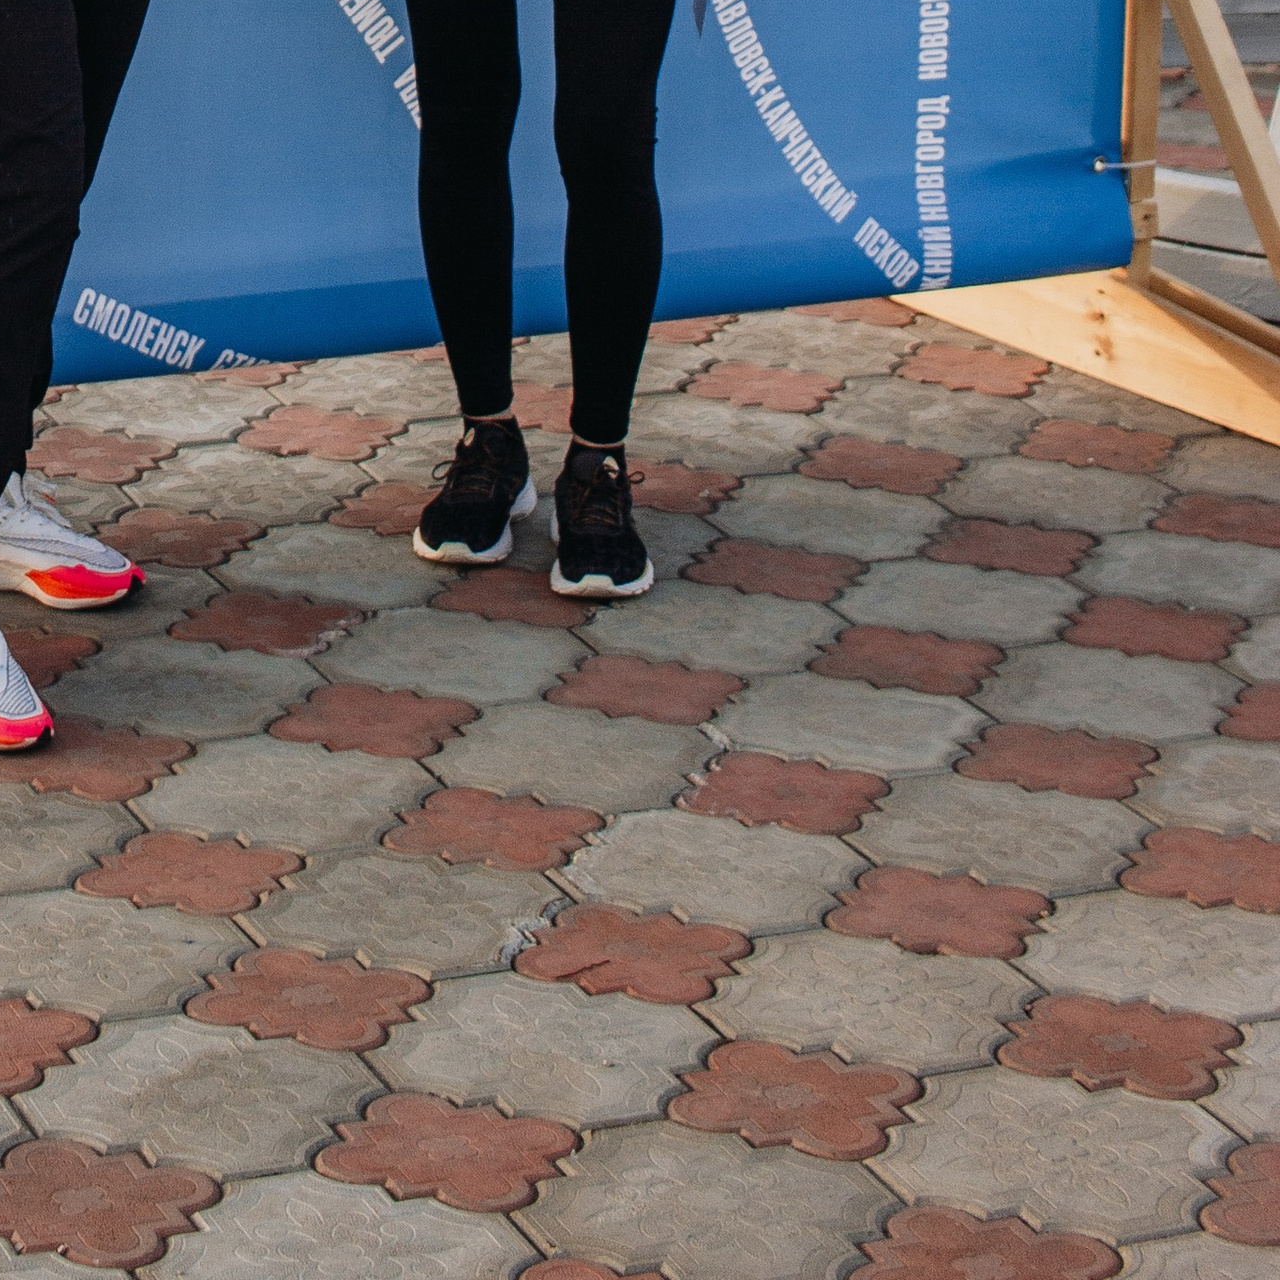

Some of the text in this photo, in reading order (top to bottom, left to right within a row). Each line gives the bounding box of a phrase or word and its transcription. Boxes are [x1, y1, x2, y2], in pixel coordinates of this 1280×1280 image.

[916, 95, 950, 221] НОВГОРОД
[853, 217, 920, 289] ПСКОВ
[73, 287, 206, 371] СМОЛЕНСК
